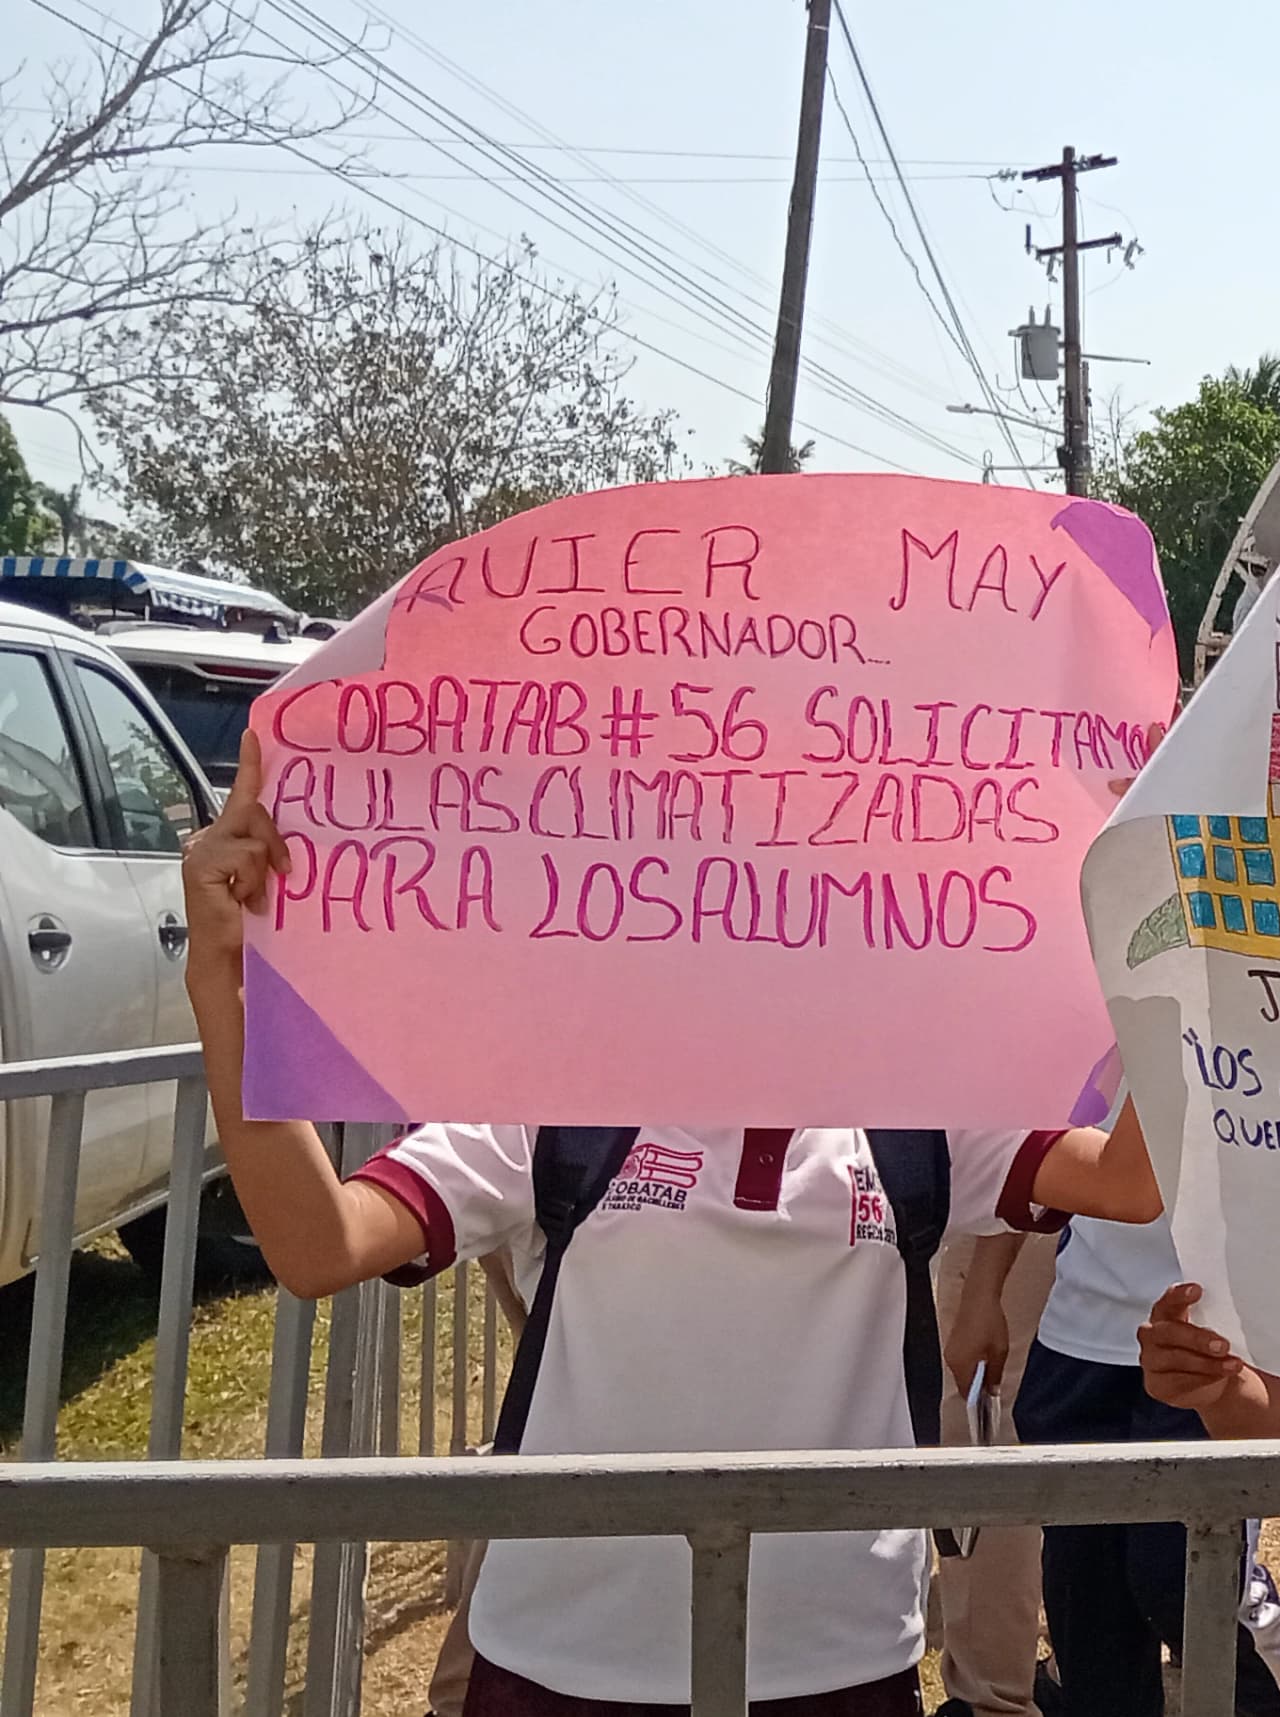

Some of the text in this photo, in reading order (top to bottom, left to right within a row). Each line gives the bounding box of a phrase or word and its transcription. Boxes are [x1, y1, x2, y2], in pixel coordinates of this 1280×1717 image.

[888, 528, 1067, 621] MAY
[275, 831, 502, 933] PARA
[612, 1180, 688, 1203] OBATAB
[859, 1194, 883, 1223] 56
